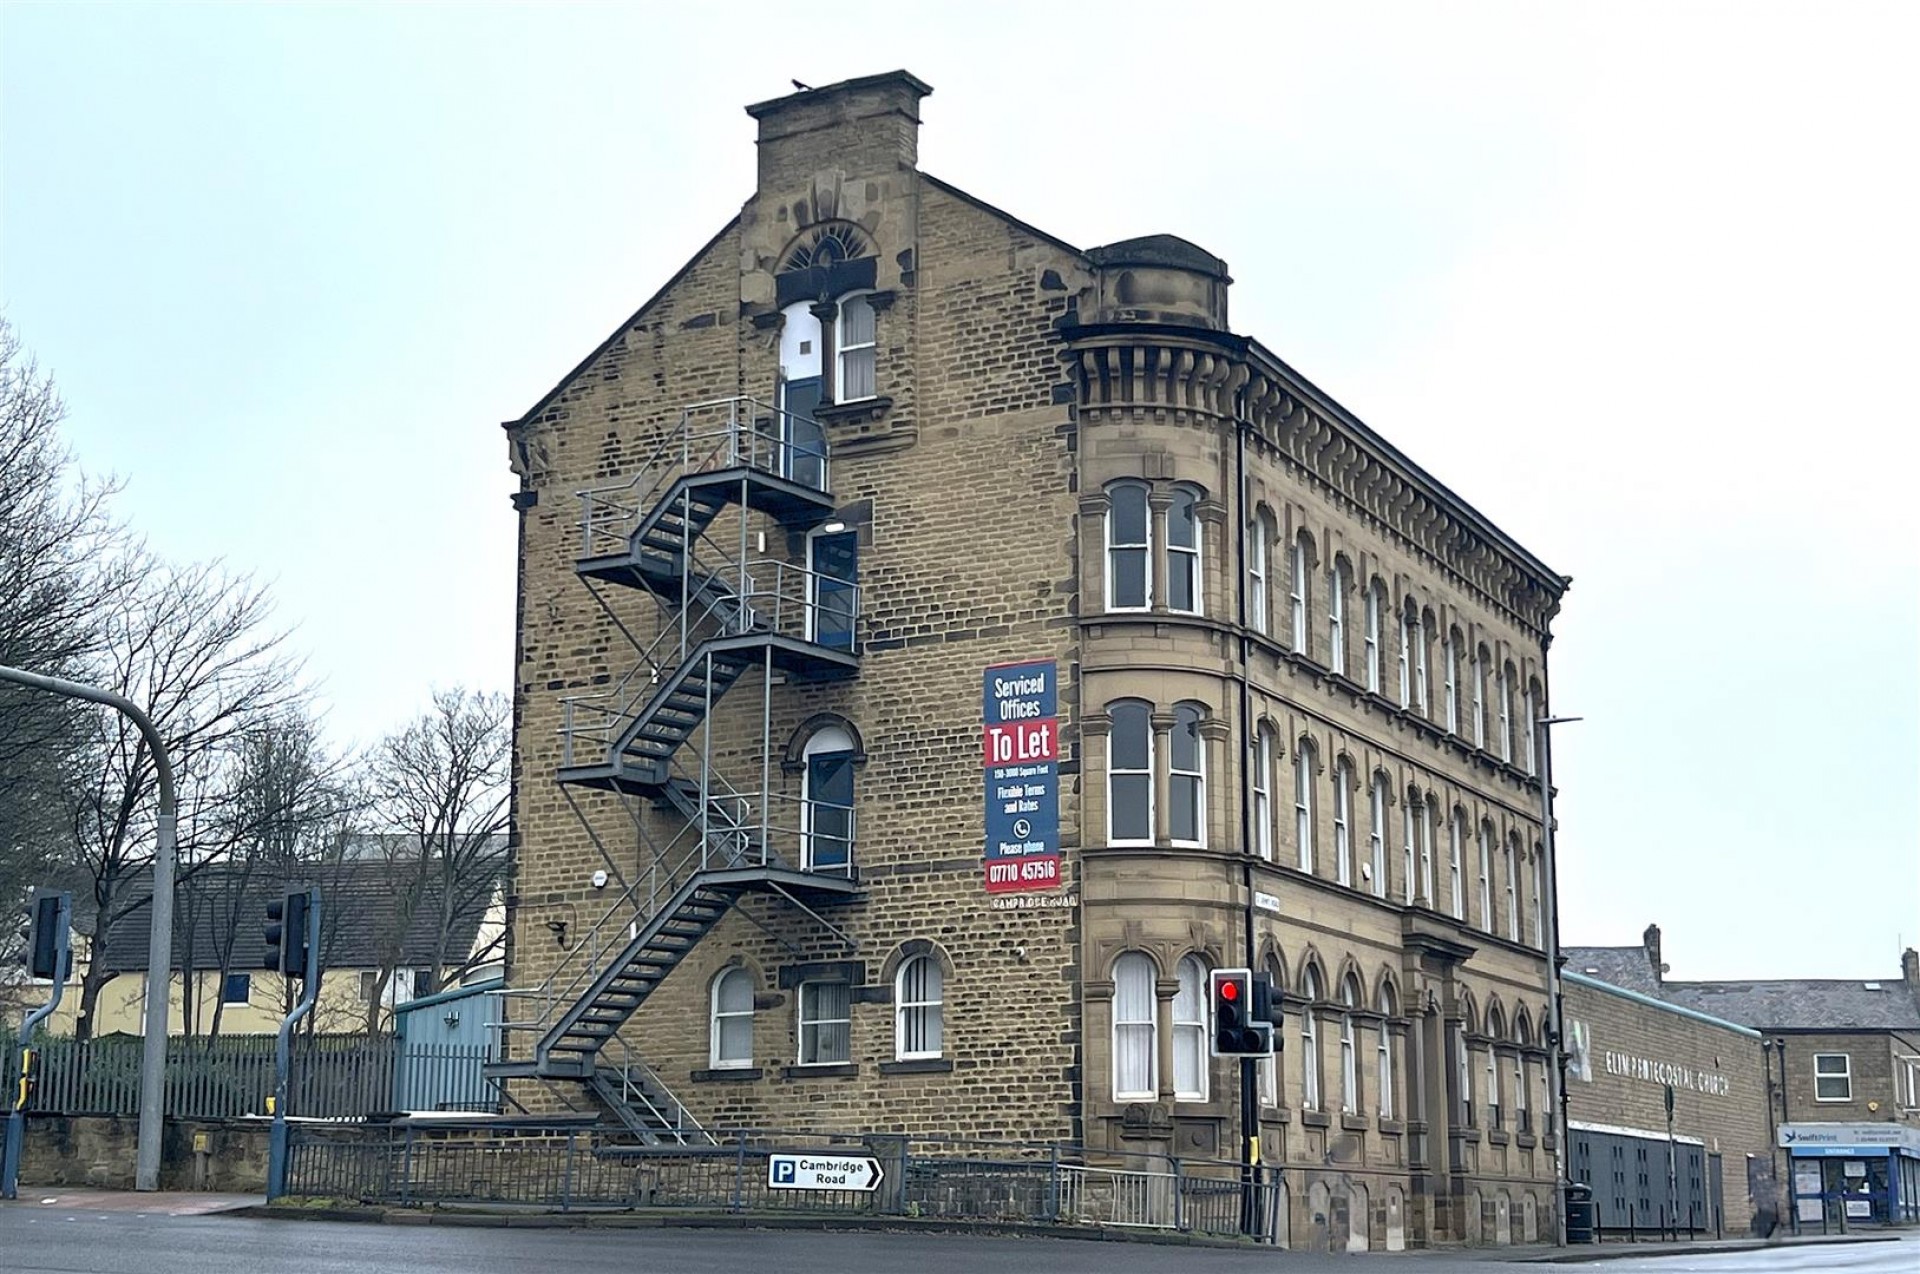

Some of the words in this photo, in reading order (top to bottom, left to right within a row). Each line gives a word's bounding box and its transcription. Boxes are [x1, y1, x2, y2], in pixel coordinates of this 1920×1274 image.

[995, 673, 1045, 698] Serviced
[1000, 698, 1040, 720] Offices
[989, 728, 1012, 762] To
[1017, 724, 1050, 759] Let
[997, 785, 1023, 800] Flexible
[1024, 783, 1045, 797] Terms
[1004, 802, 1017, 814] and
[1018, 800, 1039, 813] Rates
[1000, 842, 1022, 855] Please
[1023, 840, 1044, 856] phone
[990, 864, 1018, 883] 07710
[1021, 860, 1055, 881] 457516
[1605, 1051, 1629, 1076] ELIM
[1631, 1056, 1694, 1090] PENTECOSTAL
[778, 1162, 793, 1182] P
[799, 1160, 864, 1174] Cambridge
[816, 1173, 846, 1184] Road
